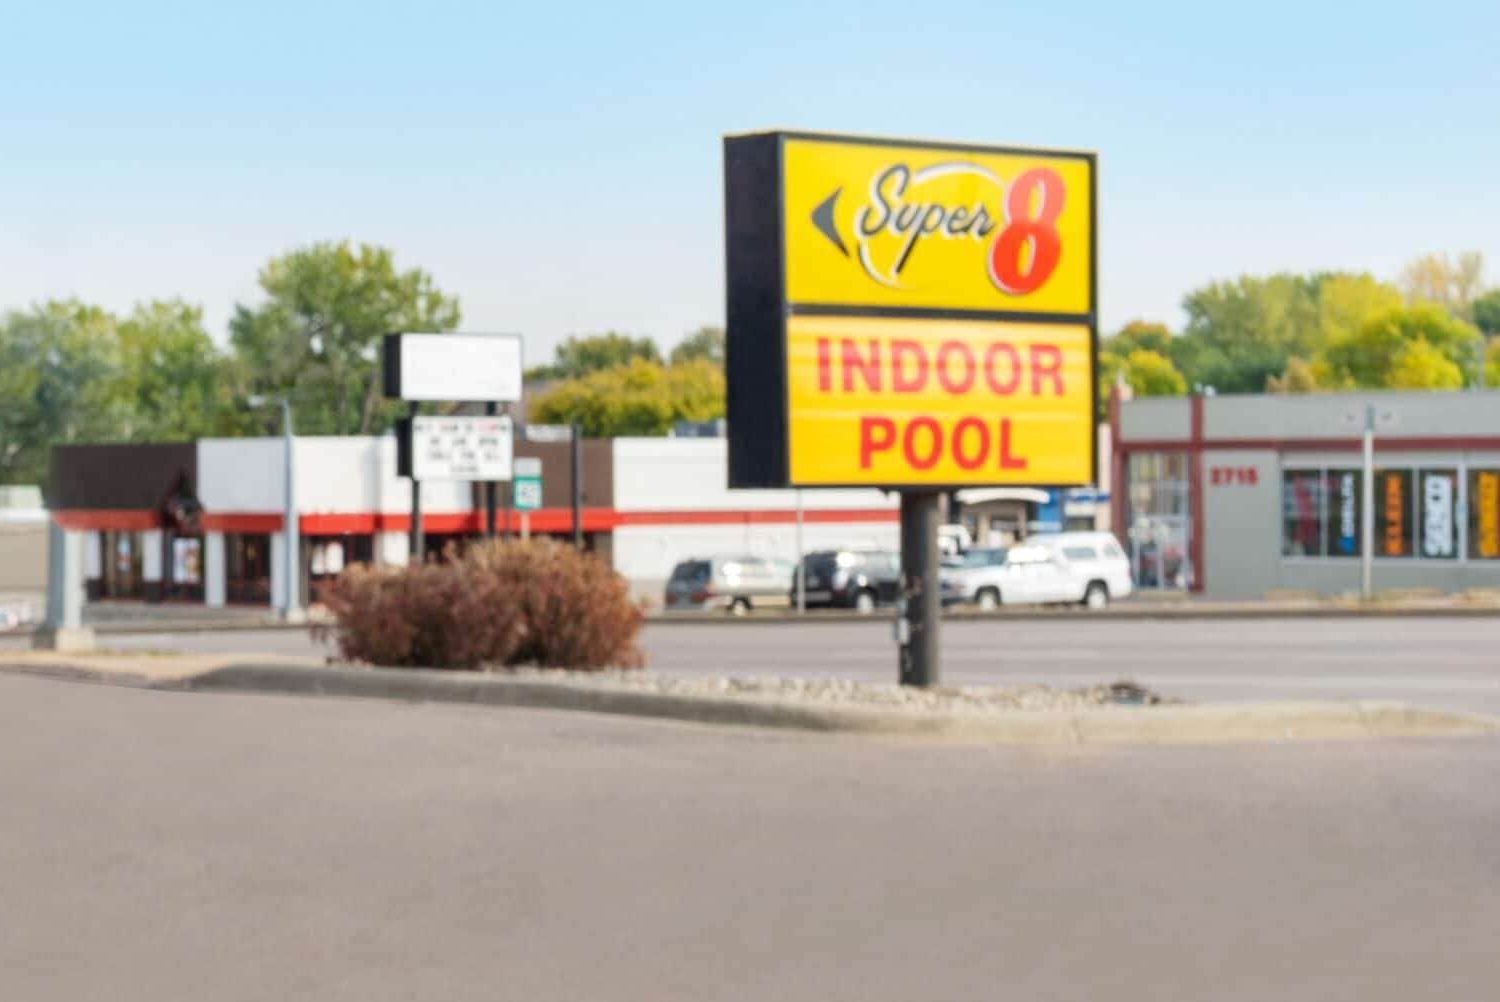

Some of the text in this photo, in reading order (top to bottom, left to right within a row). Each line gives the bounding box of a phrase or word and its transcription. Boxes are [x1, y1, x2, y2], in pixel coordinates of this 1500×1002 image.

[857, 163, 1067, 296] Super 8
[815, 336, 1066, 398] INDOOR
[858, 415, 1029, 471] POOL
